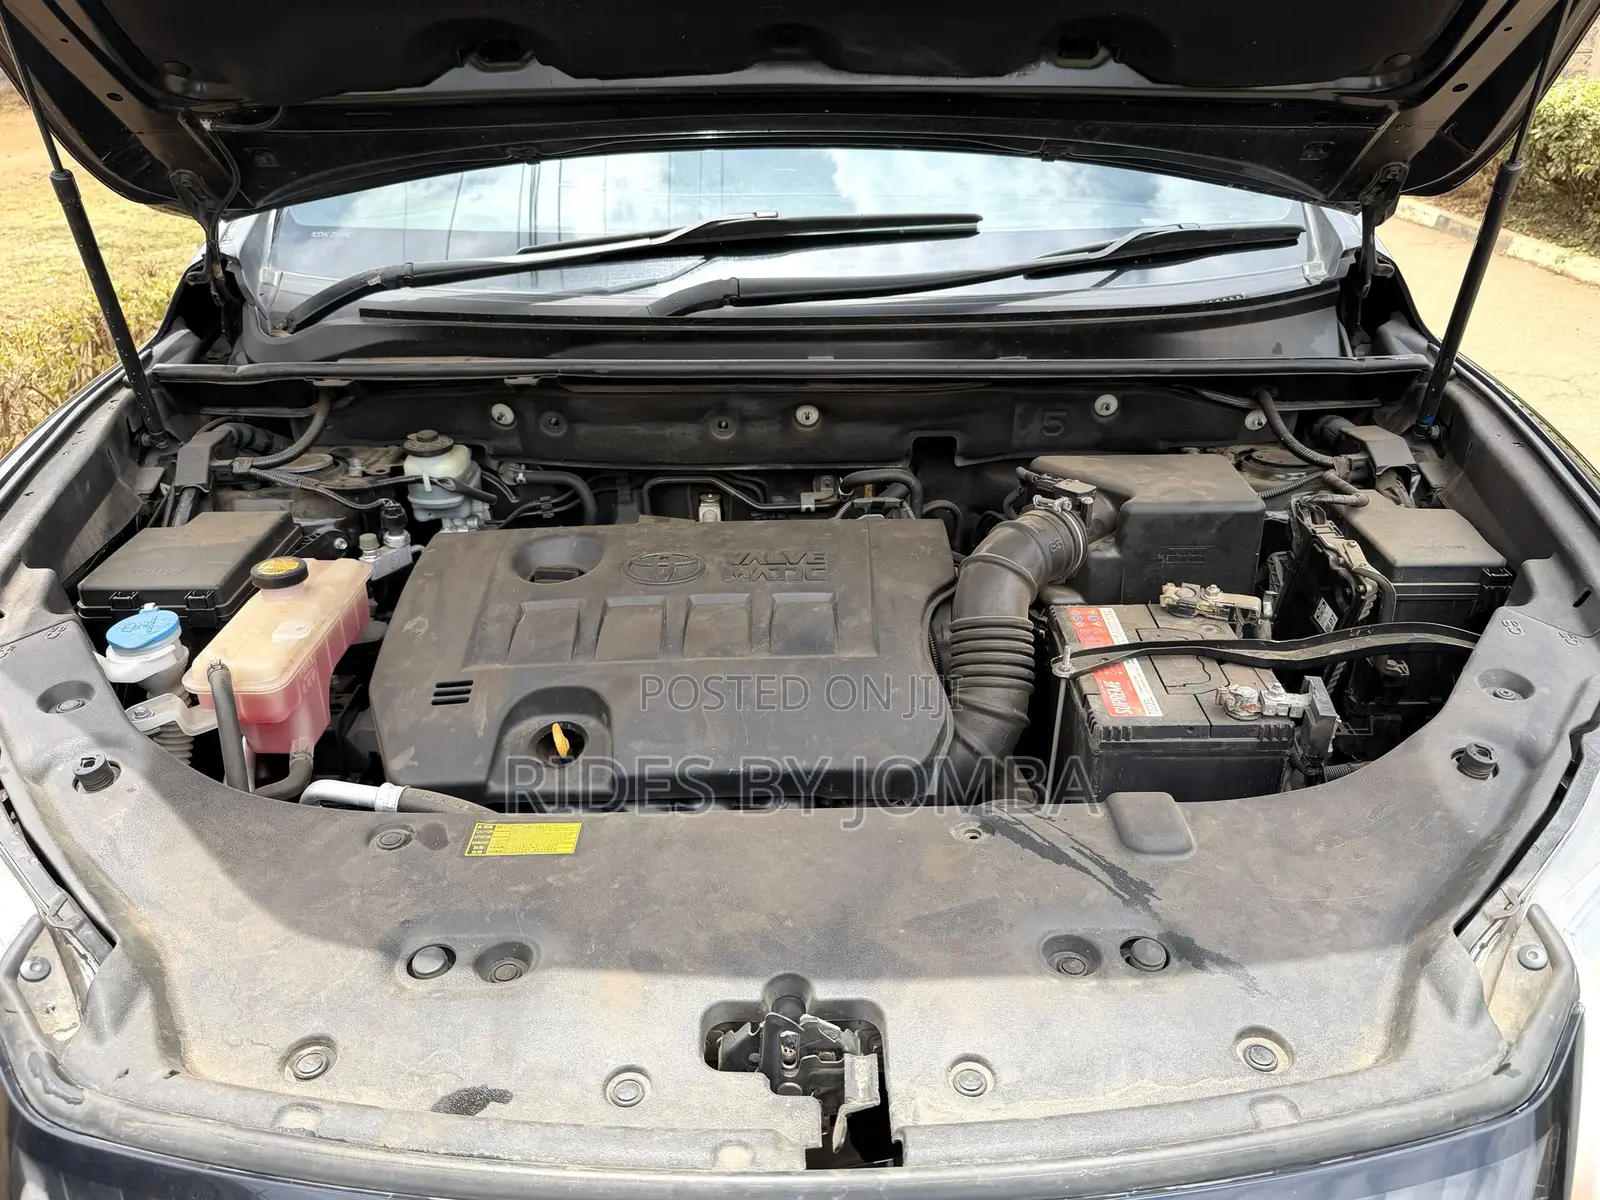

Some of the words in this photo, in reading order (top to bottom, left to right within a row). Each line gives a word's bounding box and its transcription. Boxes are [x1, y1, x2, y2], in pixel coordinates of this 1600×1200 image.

[723, 551, 827, 566] VALVE
[722, 567, 828, 582] MATIC
[1102, 680, 1133, 715] SUPREME
